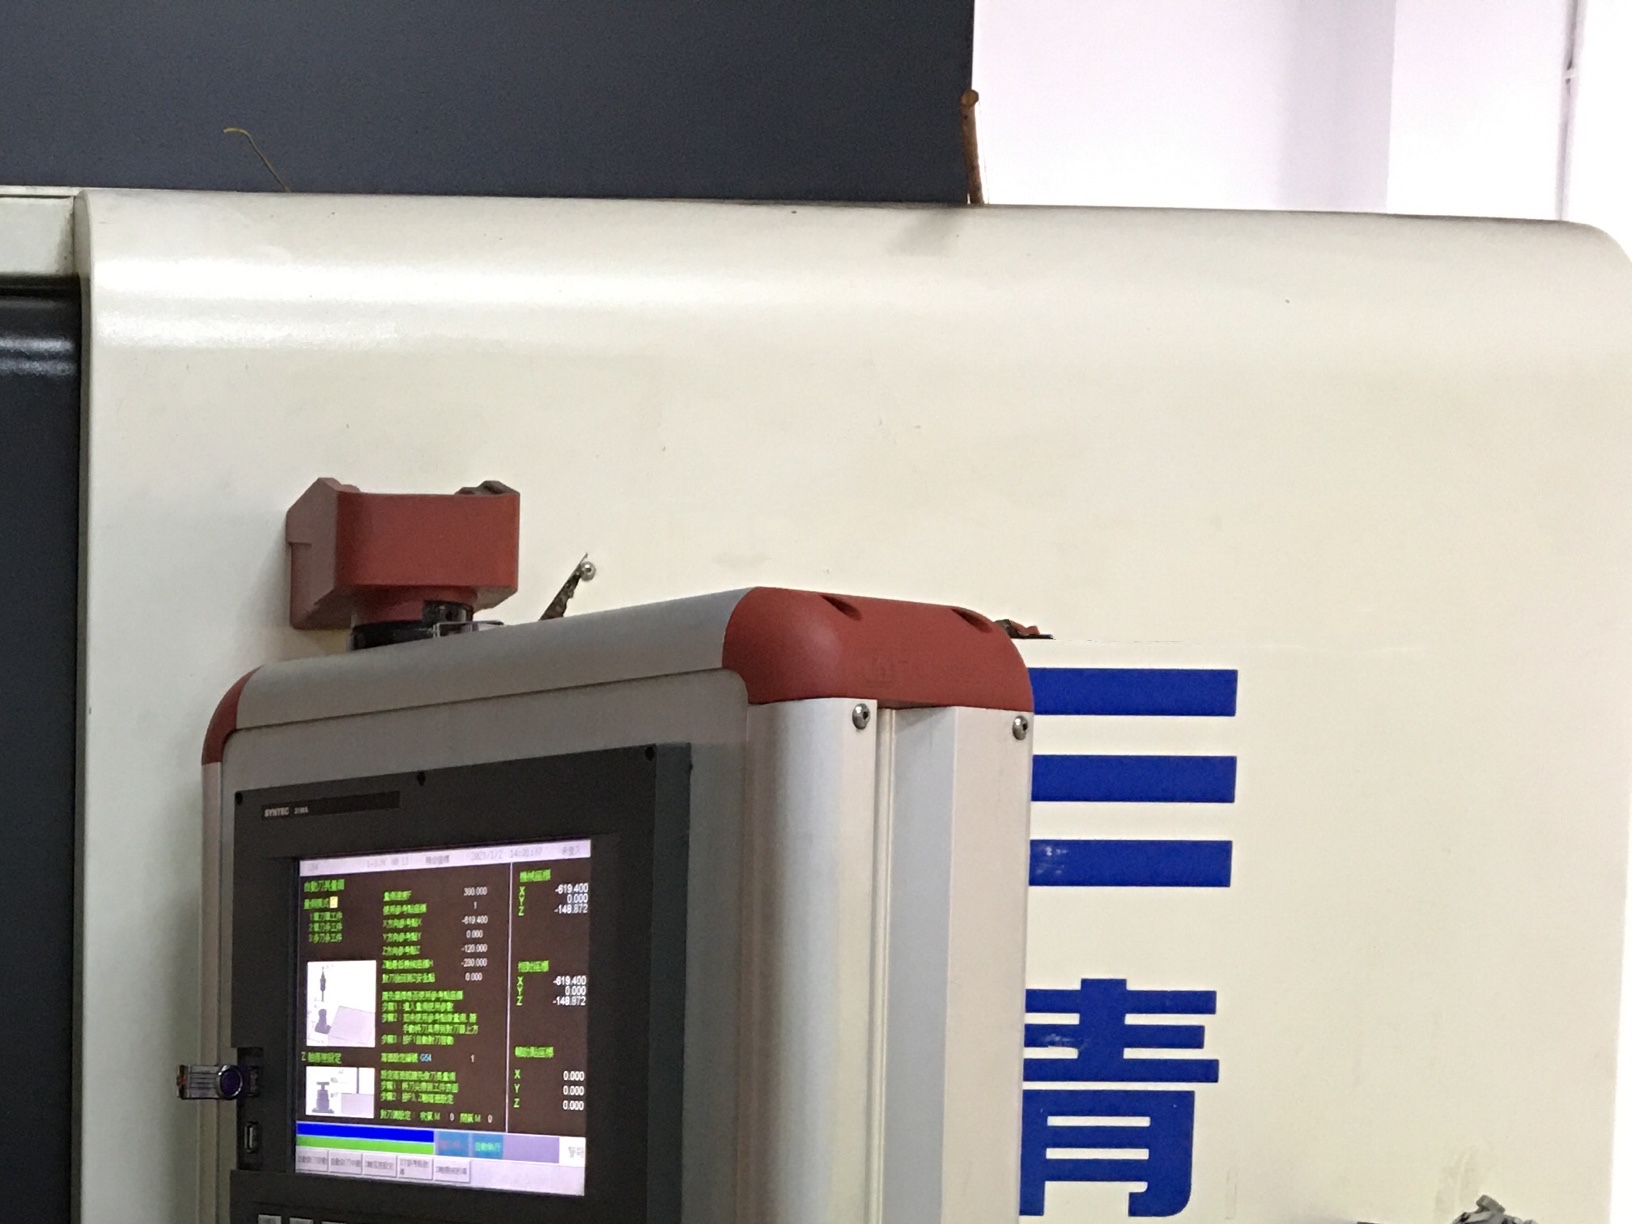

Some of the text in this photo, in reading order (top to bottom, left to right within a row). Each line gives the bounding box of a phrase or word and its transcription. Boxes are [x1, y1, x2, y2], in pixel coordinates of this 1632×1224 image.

[264, 807, 290, 818] SYNTEC
[519, 886, 525, 896] X
[518, 894, 588, 906] Y 0.000
[518, 906, 524, 916] Z
[517, 976, 523, 986] X
[517, 986, 587, 996] Y 0.000
[516, 996, 523, 1006] Z
[514, 1069, 585, 1081] X 0.000
[513, 1084, 584, 1096] Y 0.000
[513, 1099, 584, 1111] Z 0.000
